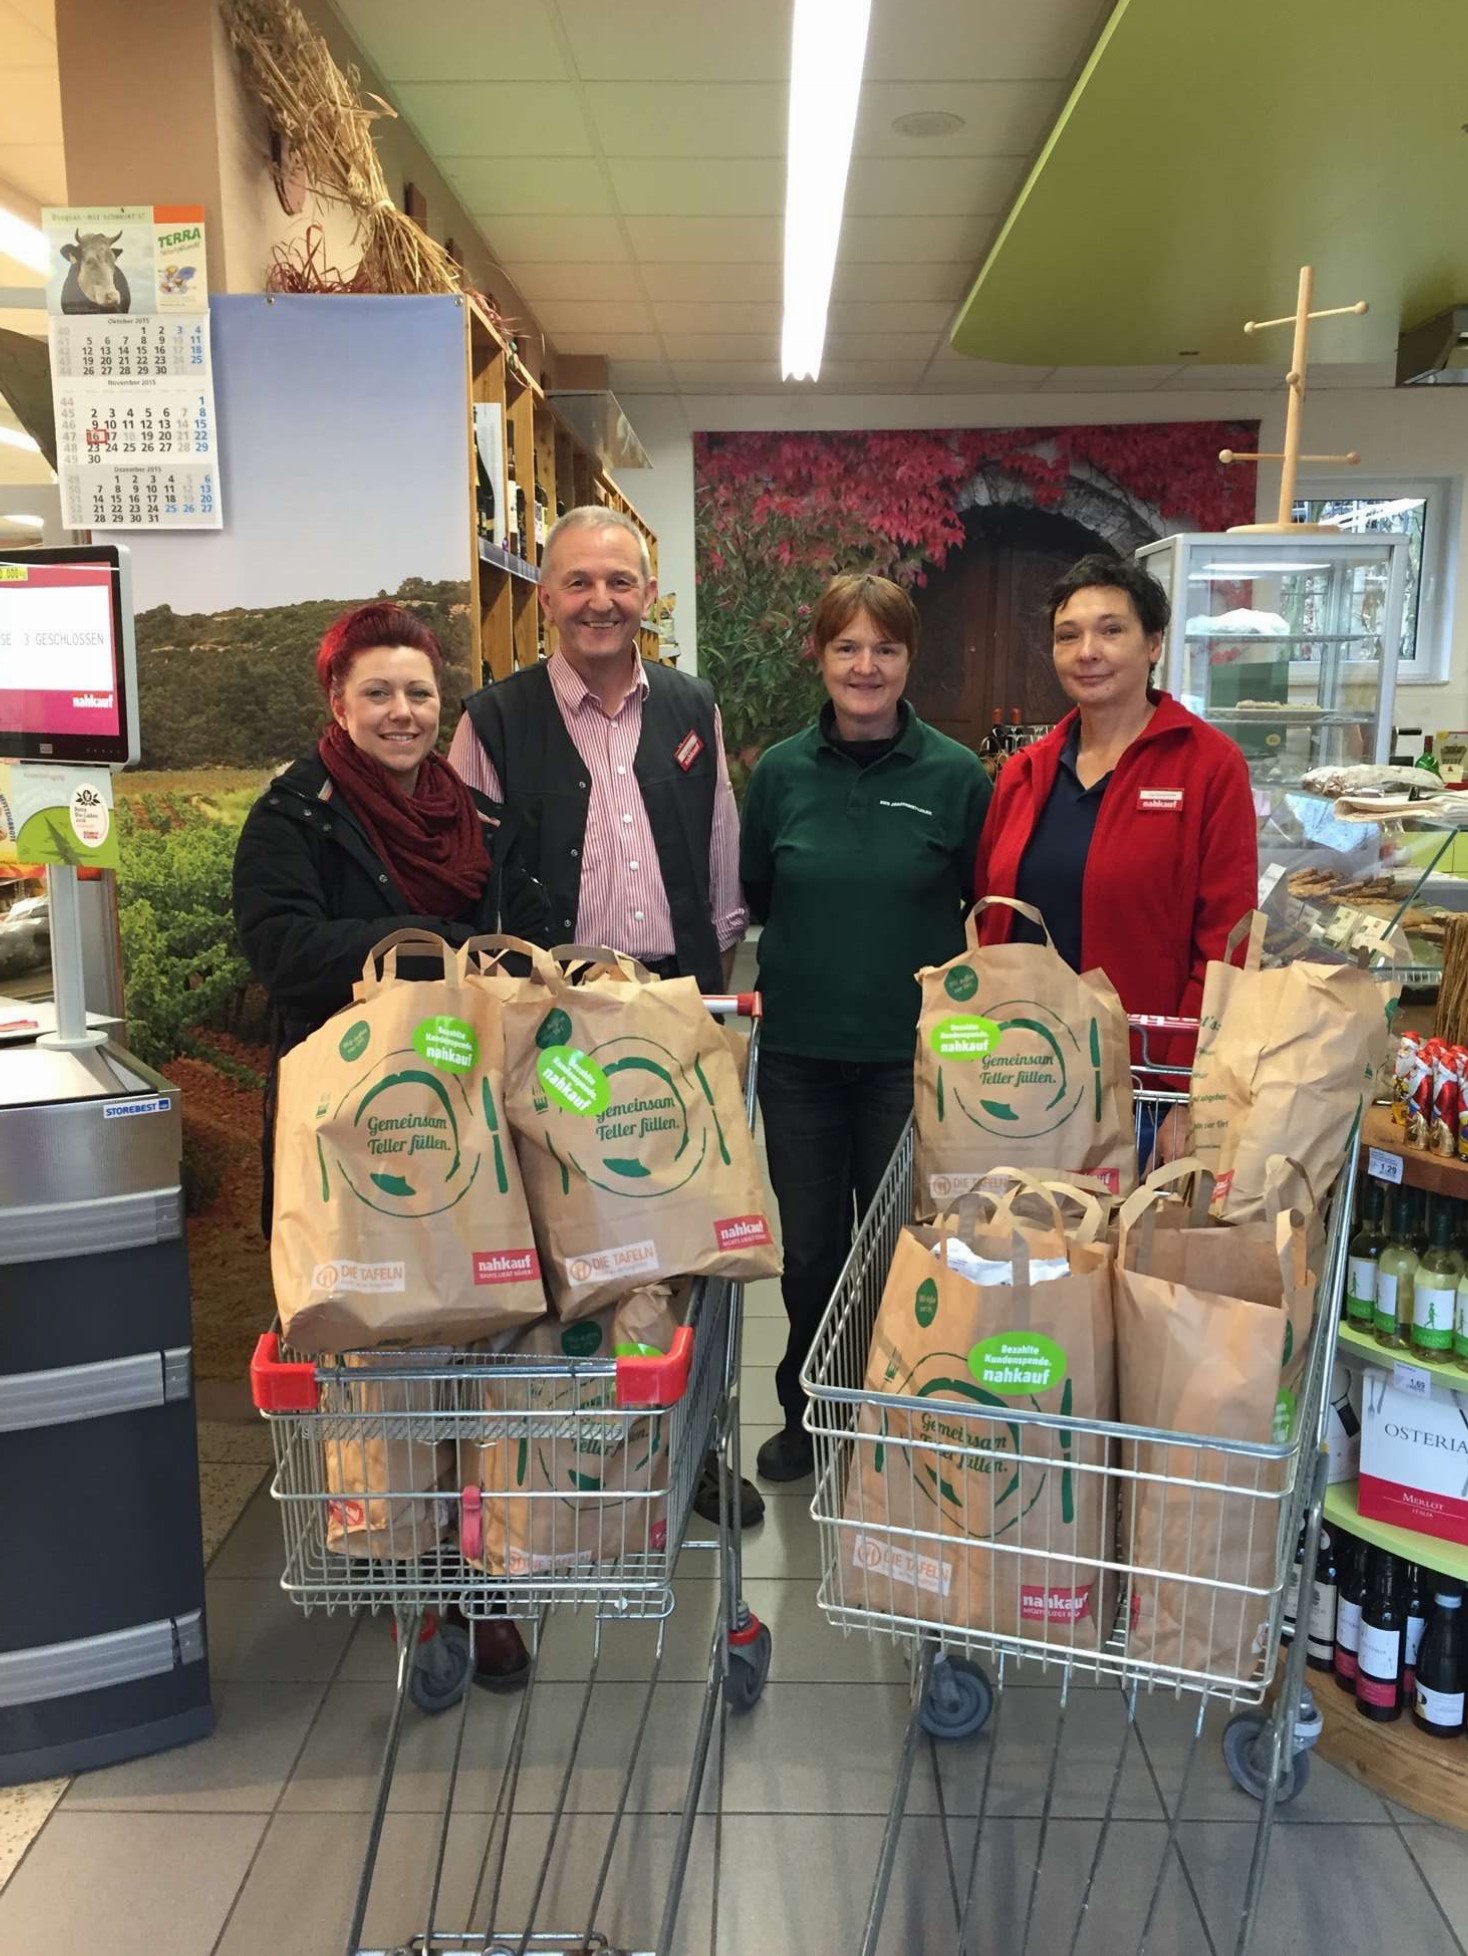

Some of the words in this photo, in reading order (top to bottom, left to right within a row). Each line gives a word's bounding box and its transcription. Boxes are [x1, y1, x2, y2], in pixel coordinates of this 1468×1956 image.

[158, 227, 201, 248] TERRA
[190, 336, 201, 344] 11
[82, 347, 93, 355] 12
[83, 357, 93, 365] 19
[100, 357, 112, 365] 20
[155, 356, 166, 364] 23
[191, 356, 202, 364] 25
[83, 367, 94, 375] 26
[101, 367, 112, 375] 27
[119, 367, 131, 375] 28
[137, 366, 148, 374] 29
[155, 366, 167, 374] 30
[104, 420, 116, 429] 10
[122, 420, 134, 429] 11
[140, 420, 153, 429] 12
[158, 420, 171, 429] 13
[195, 419, 207, 428] 15
[88, 432, 99, 440] 16
[105, 432, 117, 440] 17
[141, 432, 153, 440] 19
[158, 431, 172, 440] 20
[194, 431, 208, 440] 22
[88, 443, 100, 452] 23
[105, 443, 118, 452] 24
[123, 443, 136, 452] 25
[141, 443, 154, 452] 26
[159, 443, 172, 452] 27
[195, 442, 208, 452] 29
[88, 455, 101, 464] 30
[201, 495, 212, 503] 20
[93, 505, 104, 513] 21
[111, 505, 122, 513] 22
[129, 505, 141, 513] 23
[147, 505, 159, 513] 24
[165, 504, 177, 512] 25
[183, 504, 194, 512] 26
[201, 504, 213, 512] 27
[94, 515, 106, 523] 28
[112, 515, 124, 523] 29
[130, 514, 142, 523] 30
[149, 514, 159, 522] 31
[24, 632, 30, 646] 3
[36, 632, 104, 646] GESCHLOSSEN
[72, 694, 113, 708] nahkauf
[940, 1039, 988, 1052] nahkauf
[426, 1047, 473, 1068] nahkauf
[982, 1053, 1054, 1070] Gemeinsam
[980, 1072, 1014, 1085] Teller
[1014, 1070, 1056, 1088] füllen.
[542, 1068, 592, 1111] nahkauf
[106, 1102, 156, 1116] STOREBEST
[368, 1114, 447, 1136] Gemeinsam
[596, 1123, 636, 1141] Teller
[638, 1117, 680, 1138] füllen.
[368, 1138, 407, 1155] Teller
[407, 1134, 451, 1156] füllen.
[478, 1254, 531, 1271] nahkauf
[613, 1246, 654, 1266] TAFELN
[342, 1265, 358, 1278] DIE
[361, 1267, 403, 1280] TAFELN
[1001, 1344, 1040, 1355] Bezahlte
[984, 1354, 1052, 1366] Kundenspende.
[983, 1367, 1050, 1384] nahkauf
[1384, 1424, 1468, 1454] OSTERIA
